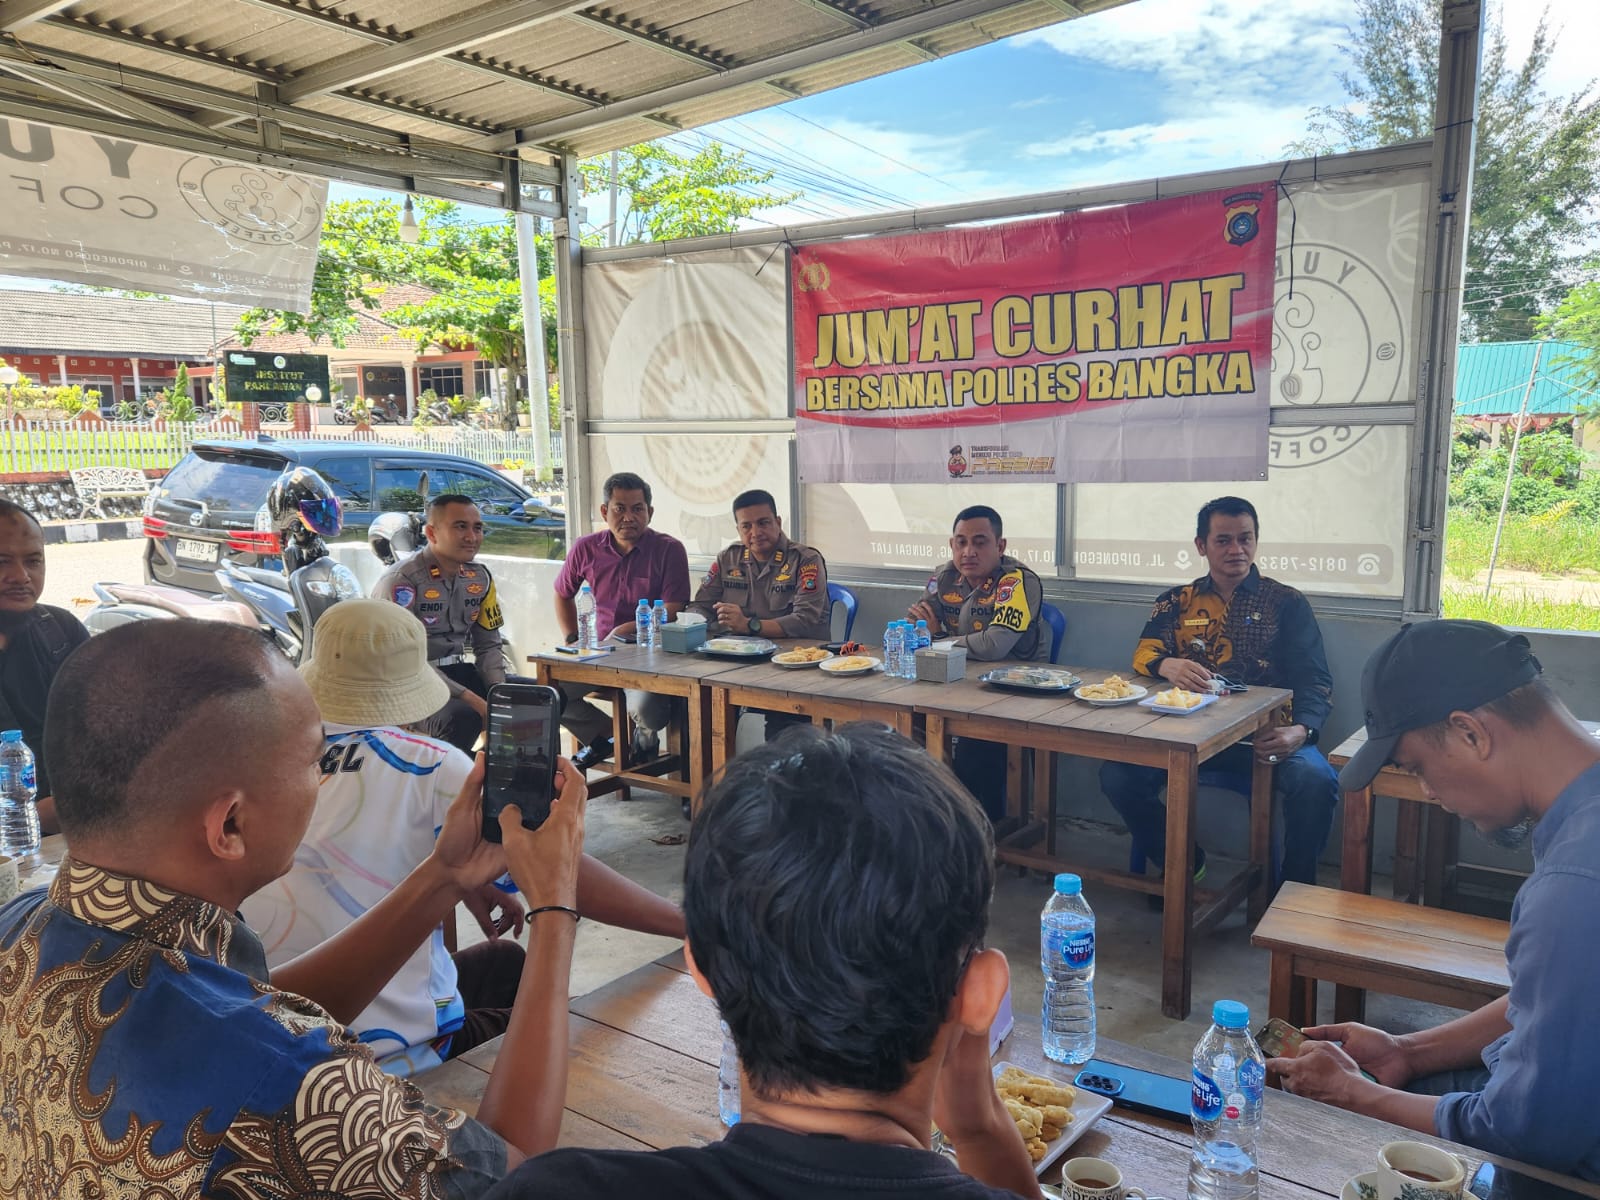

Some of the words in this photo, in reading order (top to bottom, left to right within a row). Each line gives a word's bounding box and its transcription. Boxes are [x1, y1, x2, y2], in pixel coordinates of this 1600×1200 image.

[813, 299, 982, 370] JUM'AT
[991, 272, 1245, 359] CURHAT
[805, 370, 948, 412] BERSAMA
[950, 359, 1082, 407] POLRES
[1086, 349, 1256, 401] BANGKA
[1063, 945, 1085, 955] Pure
[1201, 1090, 1221, 1107] Life
